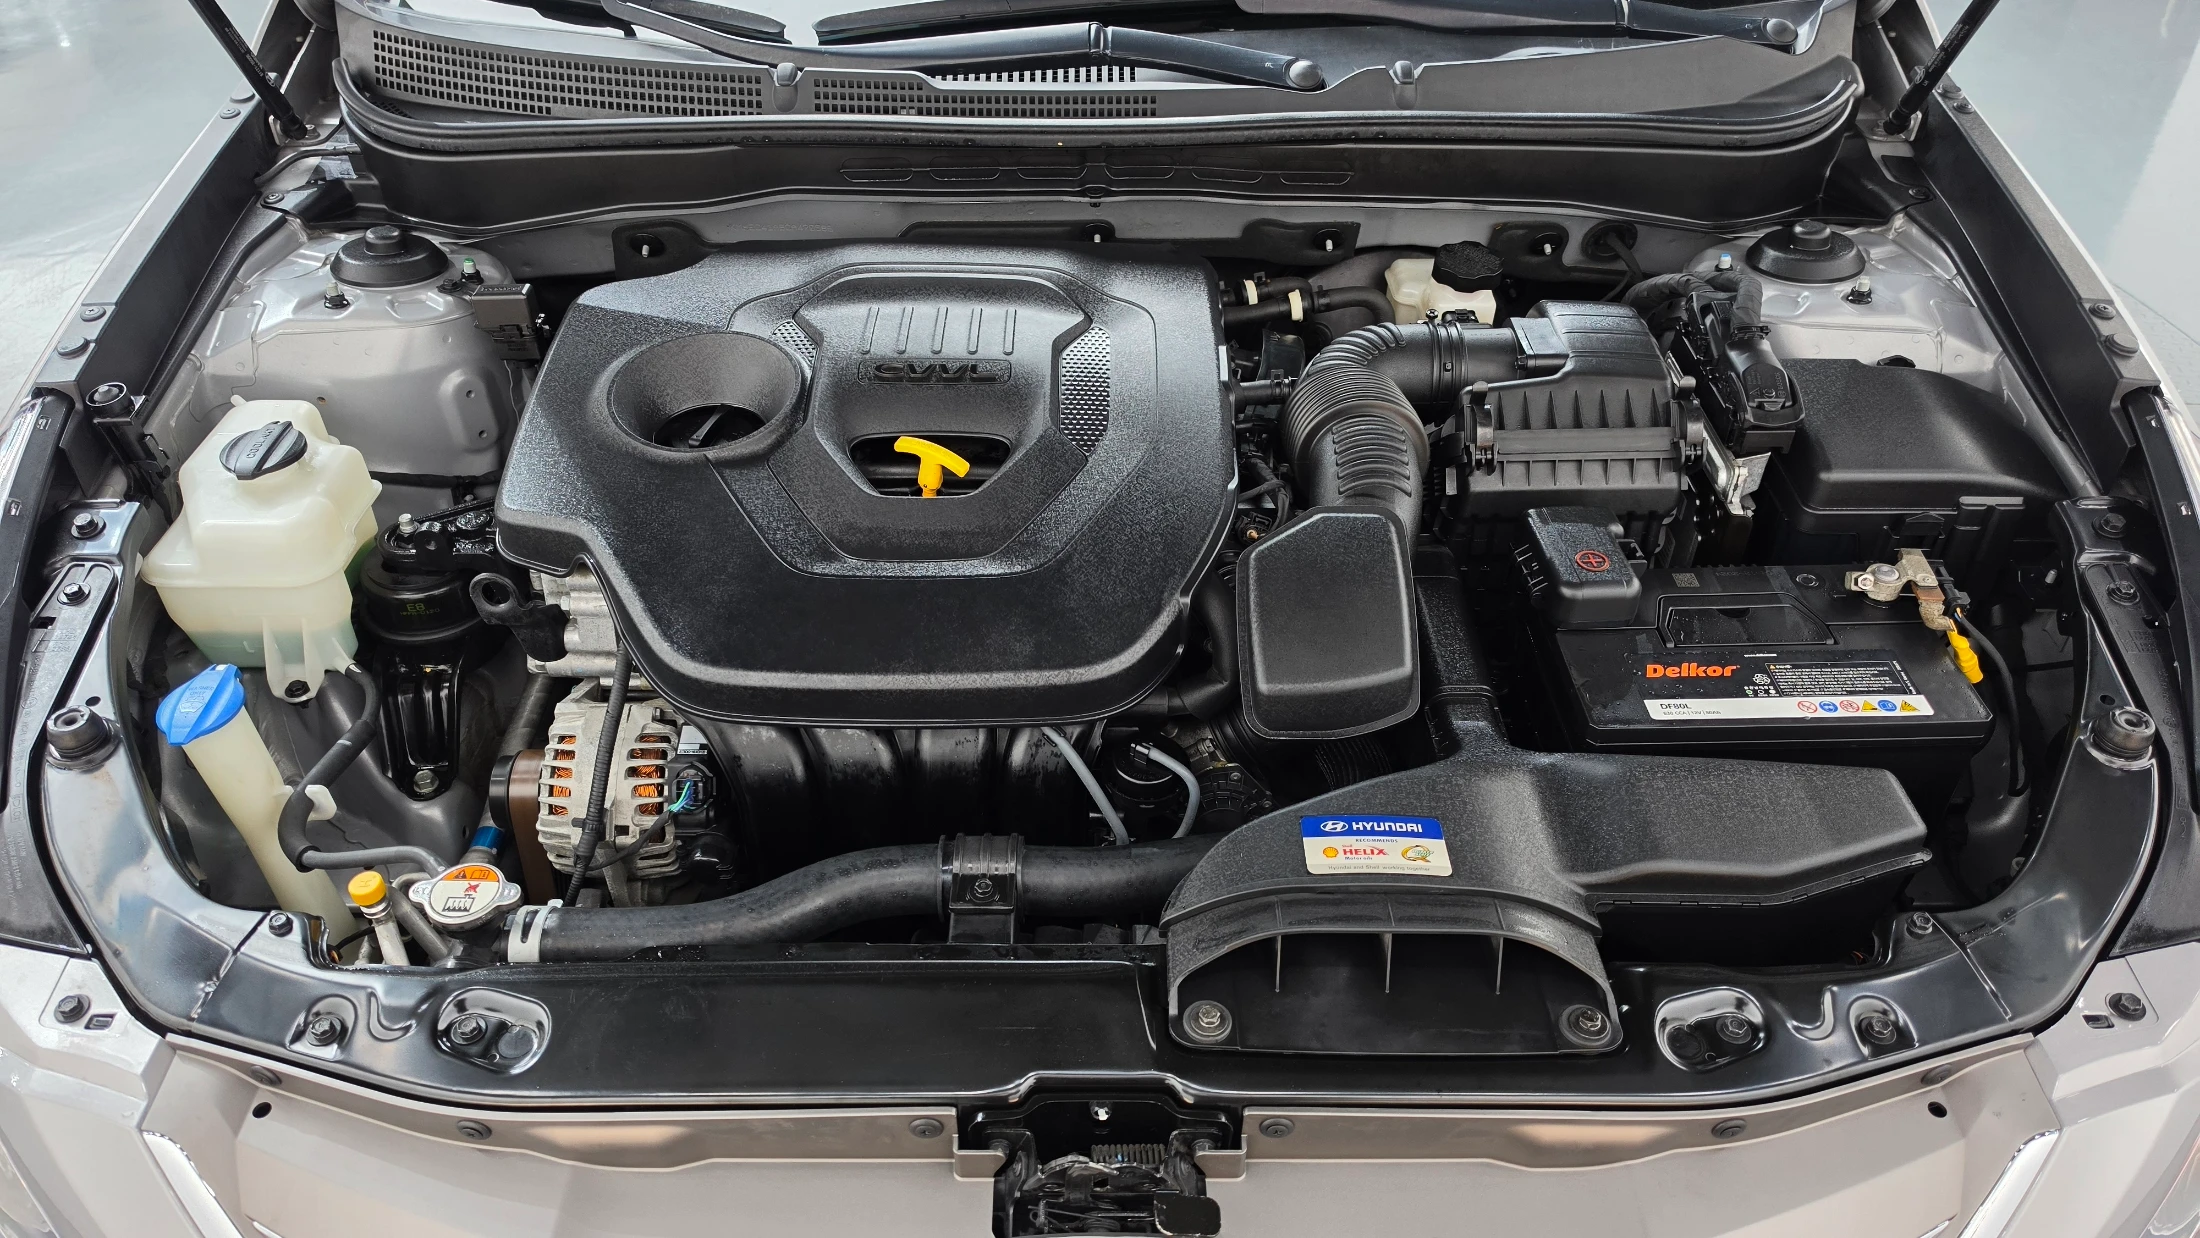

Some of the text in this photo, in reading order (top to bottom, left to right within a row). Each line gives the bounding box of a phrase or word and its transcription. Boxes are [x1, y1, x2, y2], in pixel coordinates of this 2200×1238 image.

[874, 363, 997, 382] CVVL
[1646, 662, 1737, 679] Delkor
[1352, 821, 1423, 833] HYUNDAI
[1342, 847, 1389, 856] HELIX
